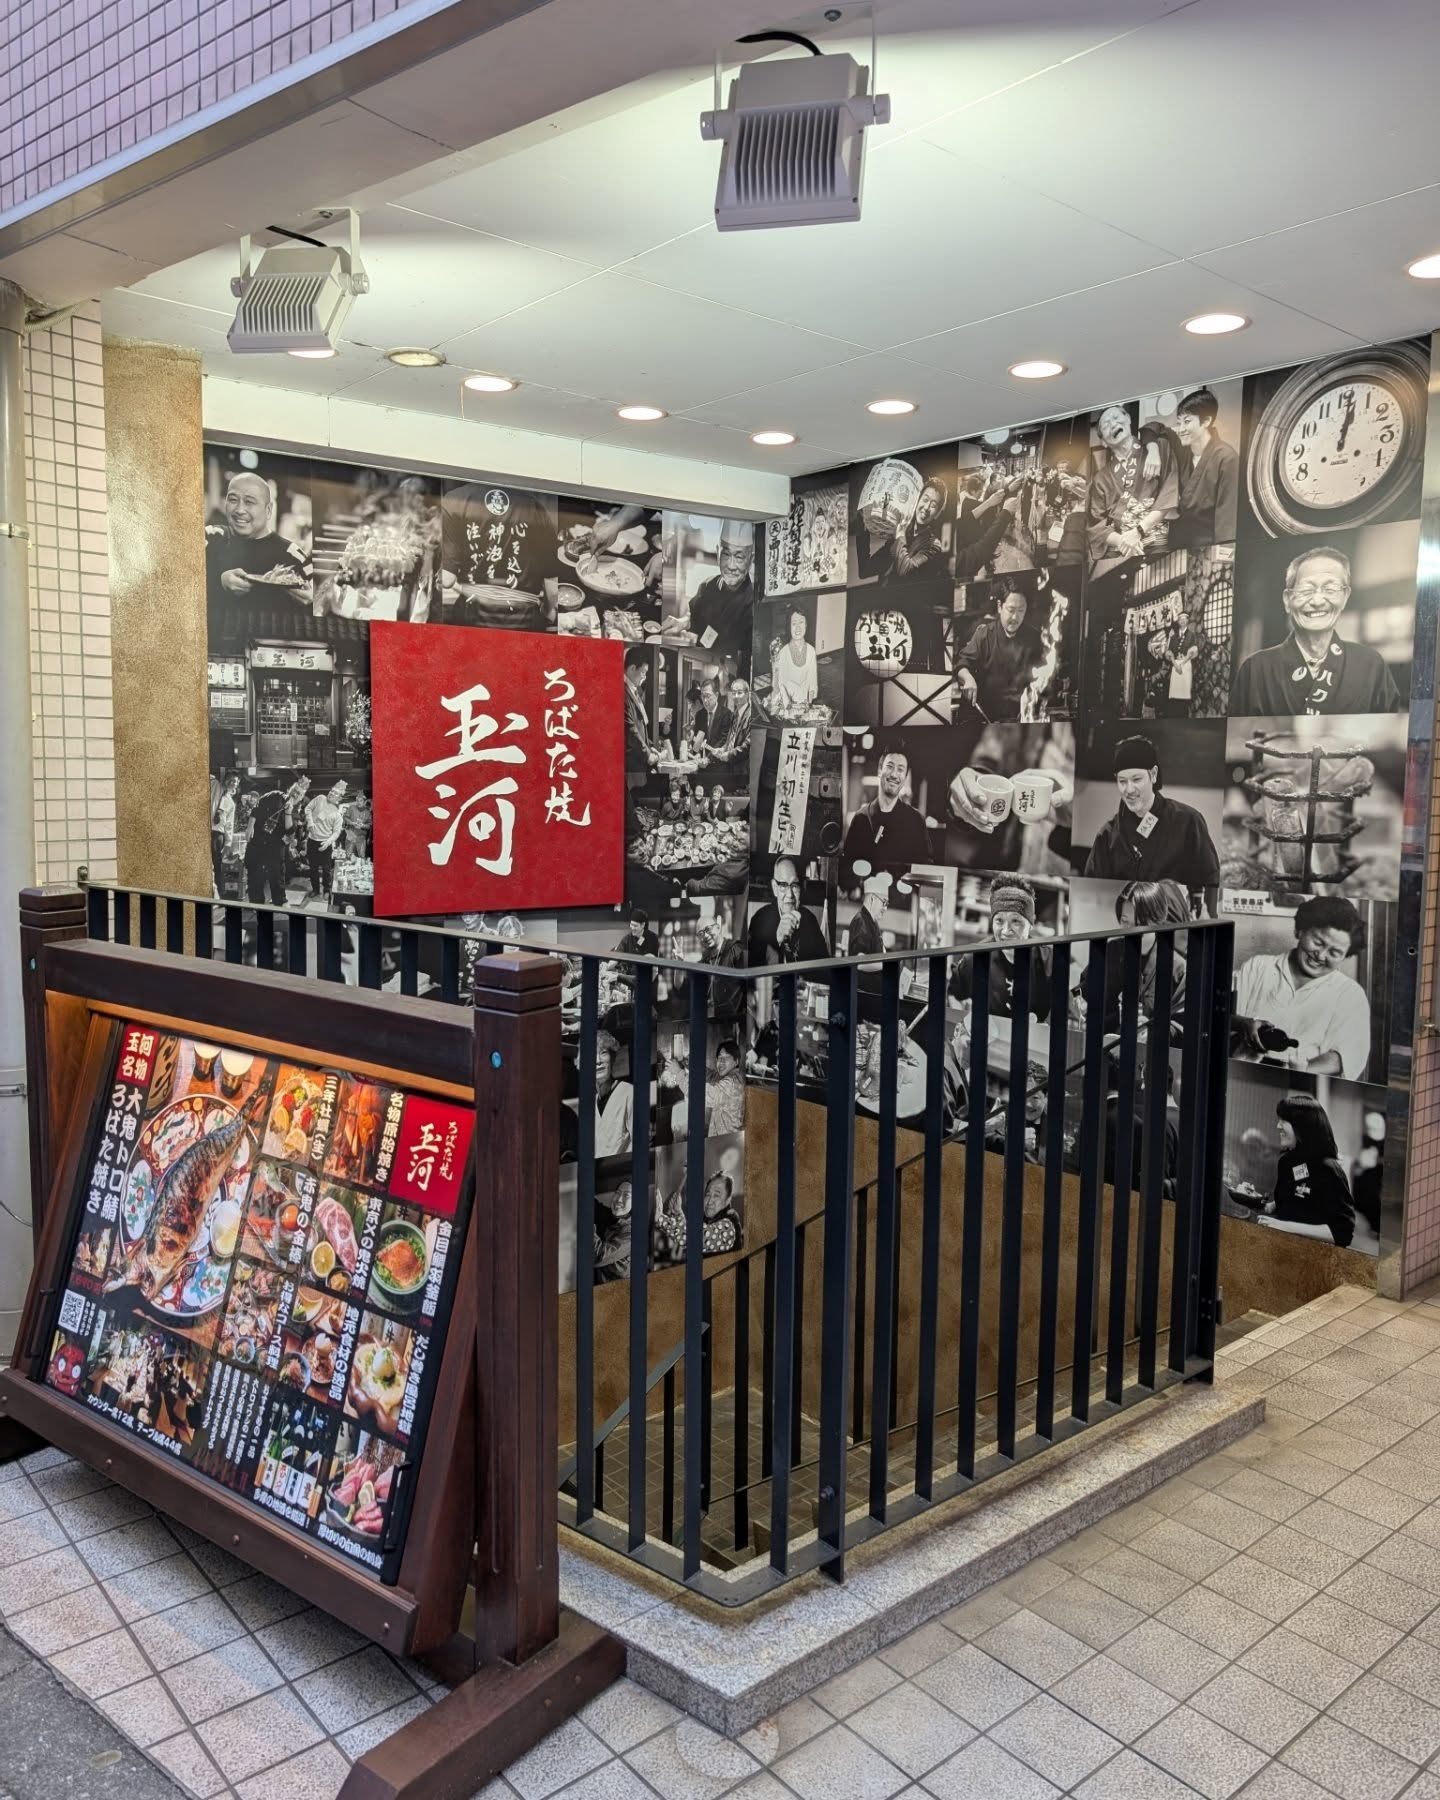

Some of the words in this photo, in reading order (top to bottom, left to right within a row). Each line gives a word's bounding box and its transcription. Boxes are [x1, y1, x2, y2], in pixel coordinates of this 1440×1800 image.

[1319, 402, 1330, 420] 11
[1365, 391, 1371, 409] 1
[1376, 402, 1389, 421] 2
[1302, 420, 1317, 439] 10
[1380, 424, 1394, 444] 3
[1293, 444, 1305, 461] 9
[1296, 463, 1308, 481] 8
[507, 523, 528, 589] 心を込め
[860, 635, 908, 666] 玉河
[542, 668, 591, 827] ろばた焼
[415, 684, 528, 876] 玉河
[772, 731, 800, 854] 立川初生ビール
[126, 1031, 154, 1057] 玉河
[122, 1055, 148, 1081] 名物
[86, 1084, 127, 1214] ろばた焼き
[101, 1087, 143, 1222] 大鬼トロ鯖
[375, 1092, 404, 1183] 名物原始焼き
[407, 1123, 443, 1192] 玉河
[439, 1121, 458, 1181] ろばた焼
[329, 1305, 360, 1402] 地元食材の逸品
